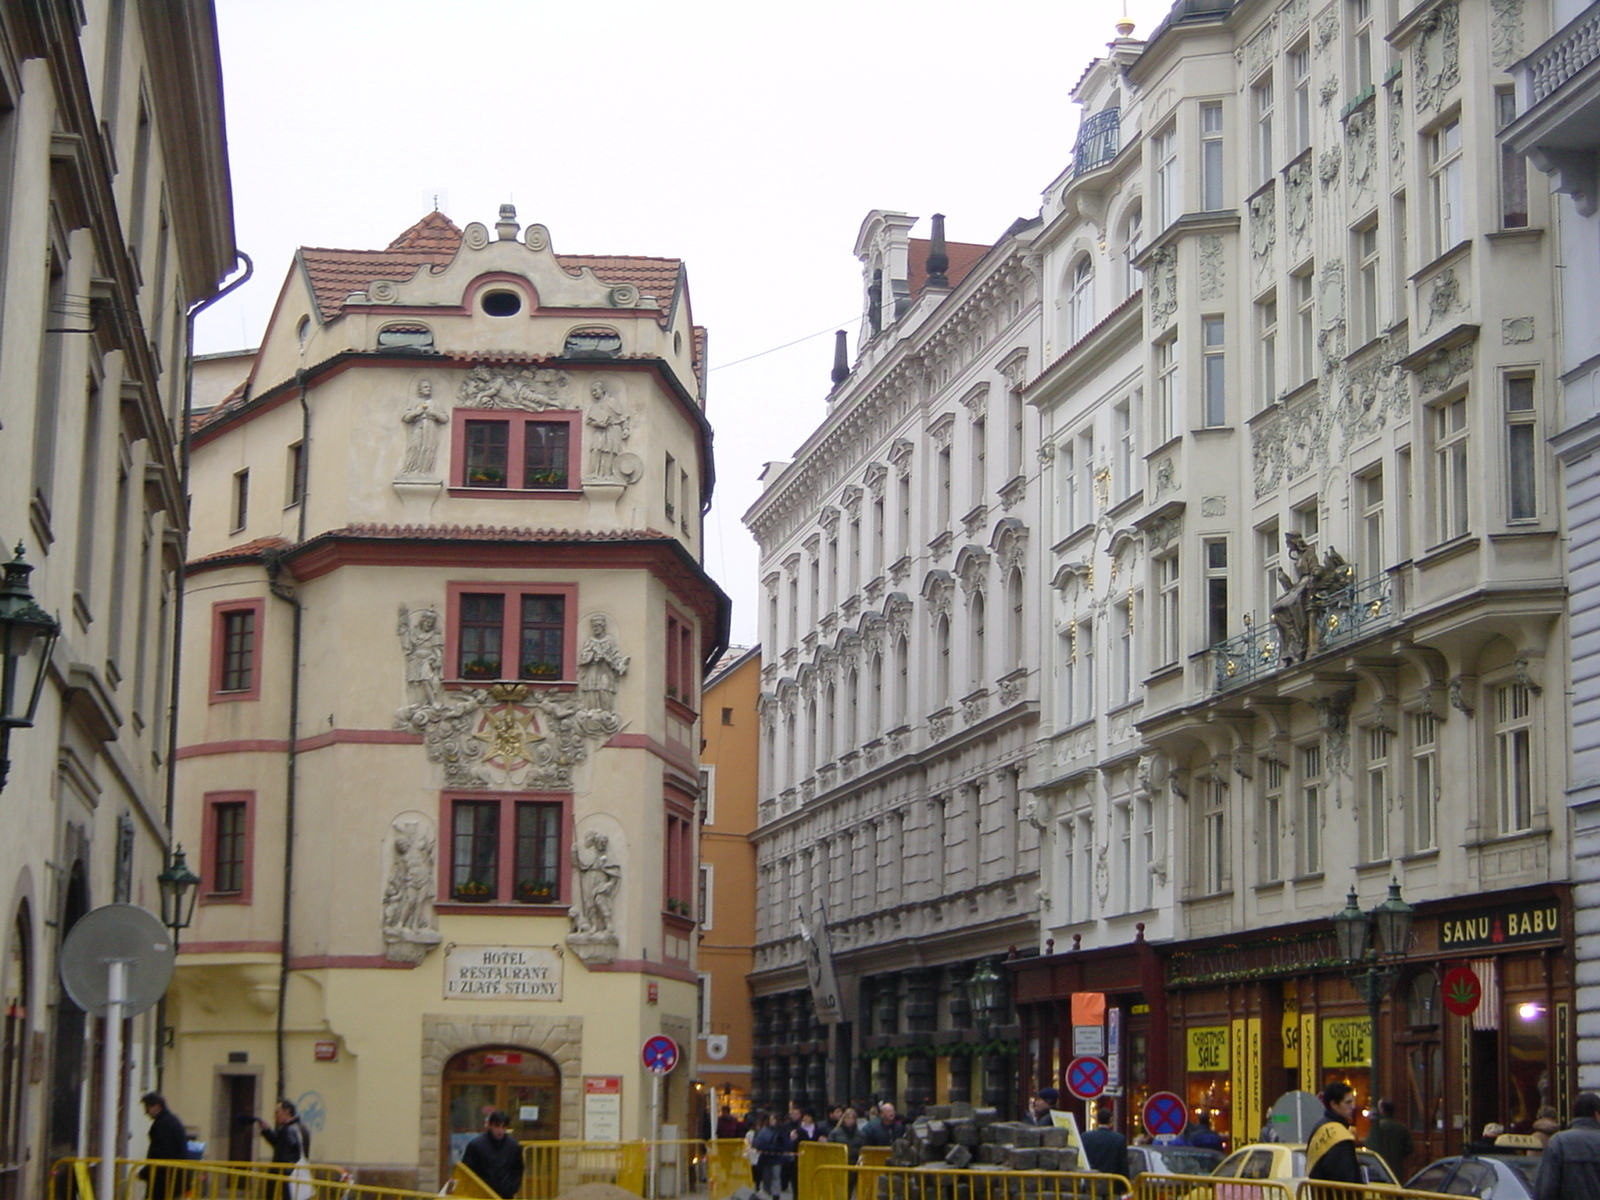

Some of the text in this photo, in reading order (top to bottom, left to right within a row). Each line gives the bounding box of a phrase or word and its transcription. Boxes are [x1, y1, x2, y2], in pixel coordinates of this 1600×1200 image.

[1443, 917, 1489, 943] SANU
[1508, 908, 1557, 936] BABU
[483, 952, 526, 966] HOTEL
[460, 967, 549, 980] RESTAURANT
[448, 980, 557, 995] U ZLATÉ STUDNY
[1193, 1030, 1225, 1047] CHRISTMAS
[1198, 1046, 1220, 1069] SALE
[1336, 1039, 1364, 1064] SALE
[1507, 1135, 1533, 1144] TAXI
